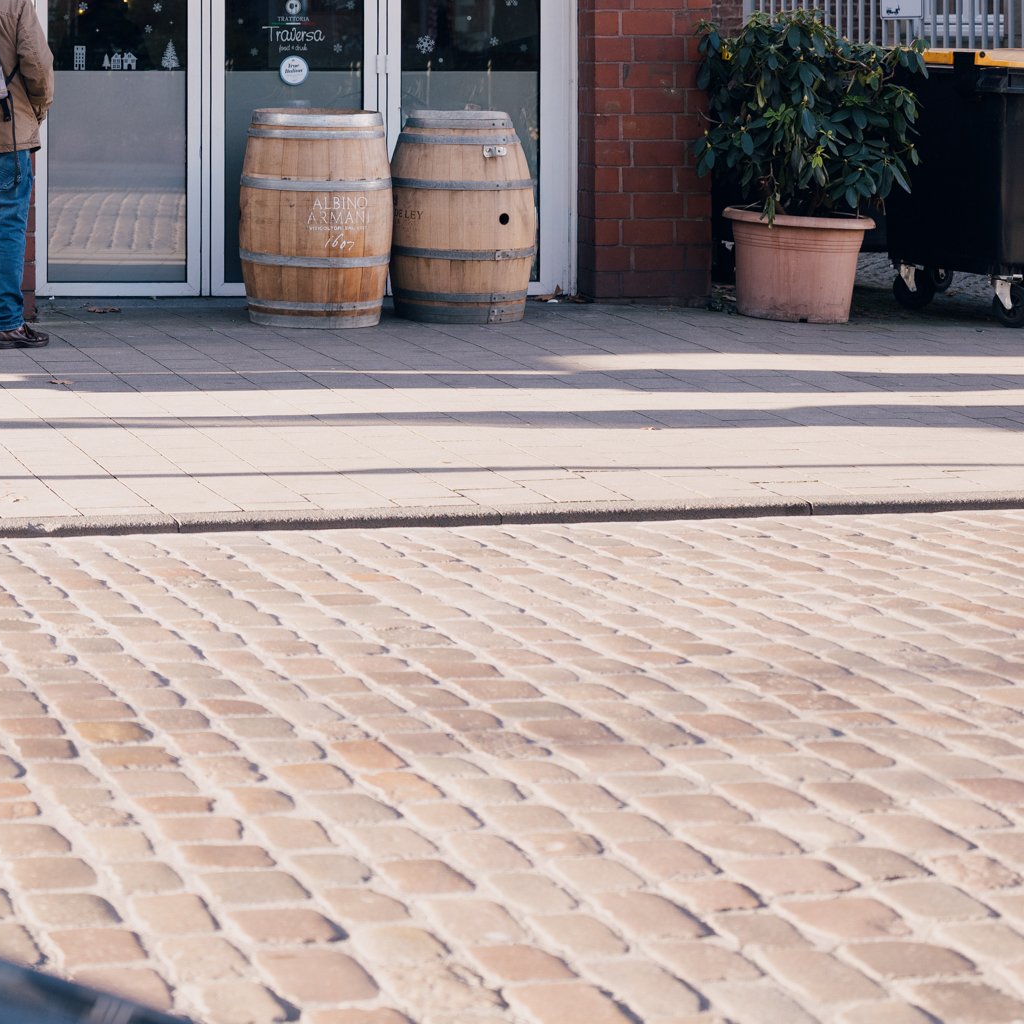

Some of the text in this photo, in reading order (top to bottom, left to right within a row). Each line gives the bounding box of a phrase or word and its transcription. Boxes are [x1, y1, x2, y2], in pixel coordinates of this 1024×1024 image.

[262, 26, 326, 42] Traversa
[313, 196, 368, 210] ALBINO
[307, 210, 370, 224] ARMANI
[404, 210, 424, 220] LEY
[324, 233, 355, 252] 1607
